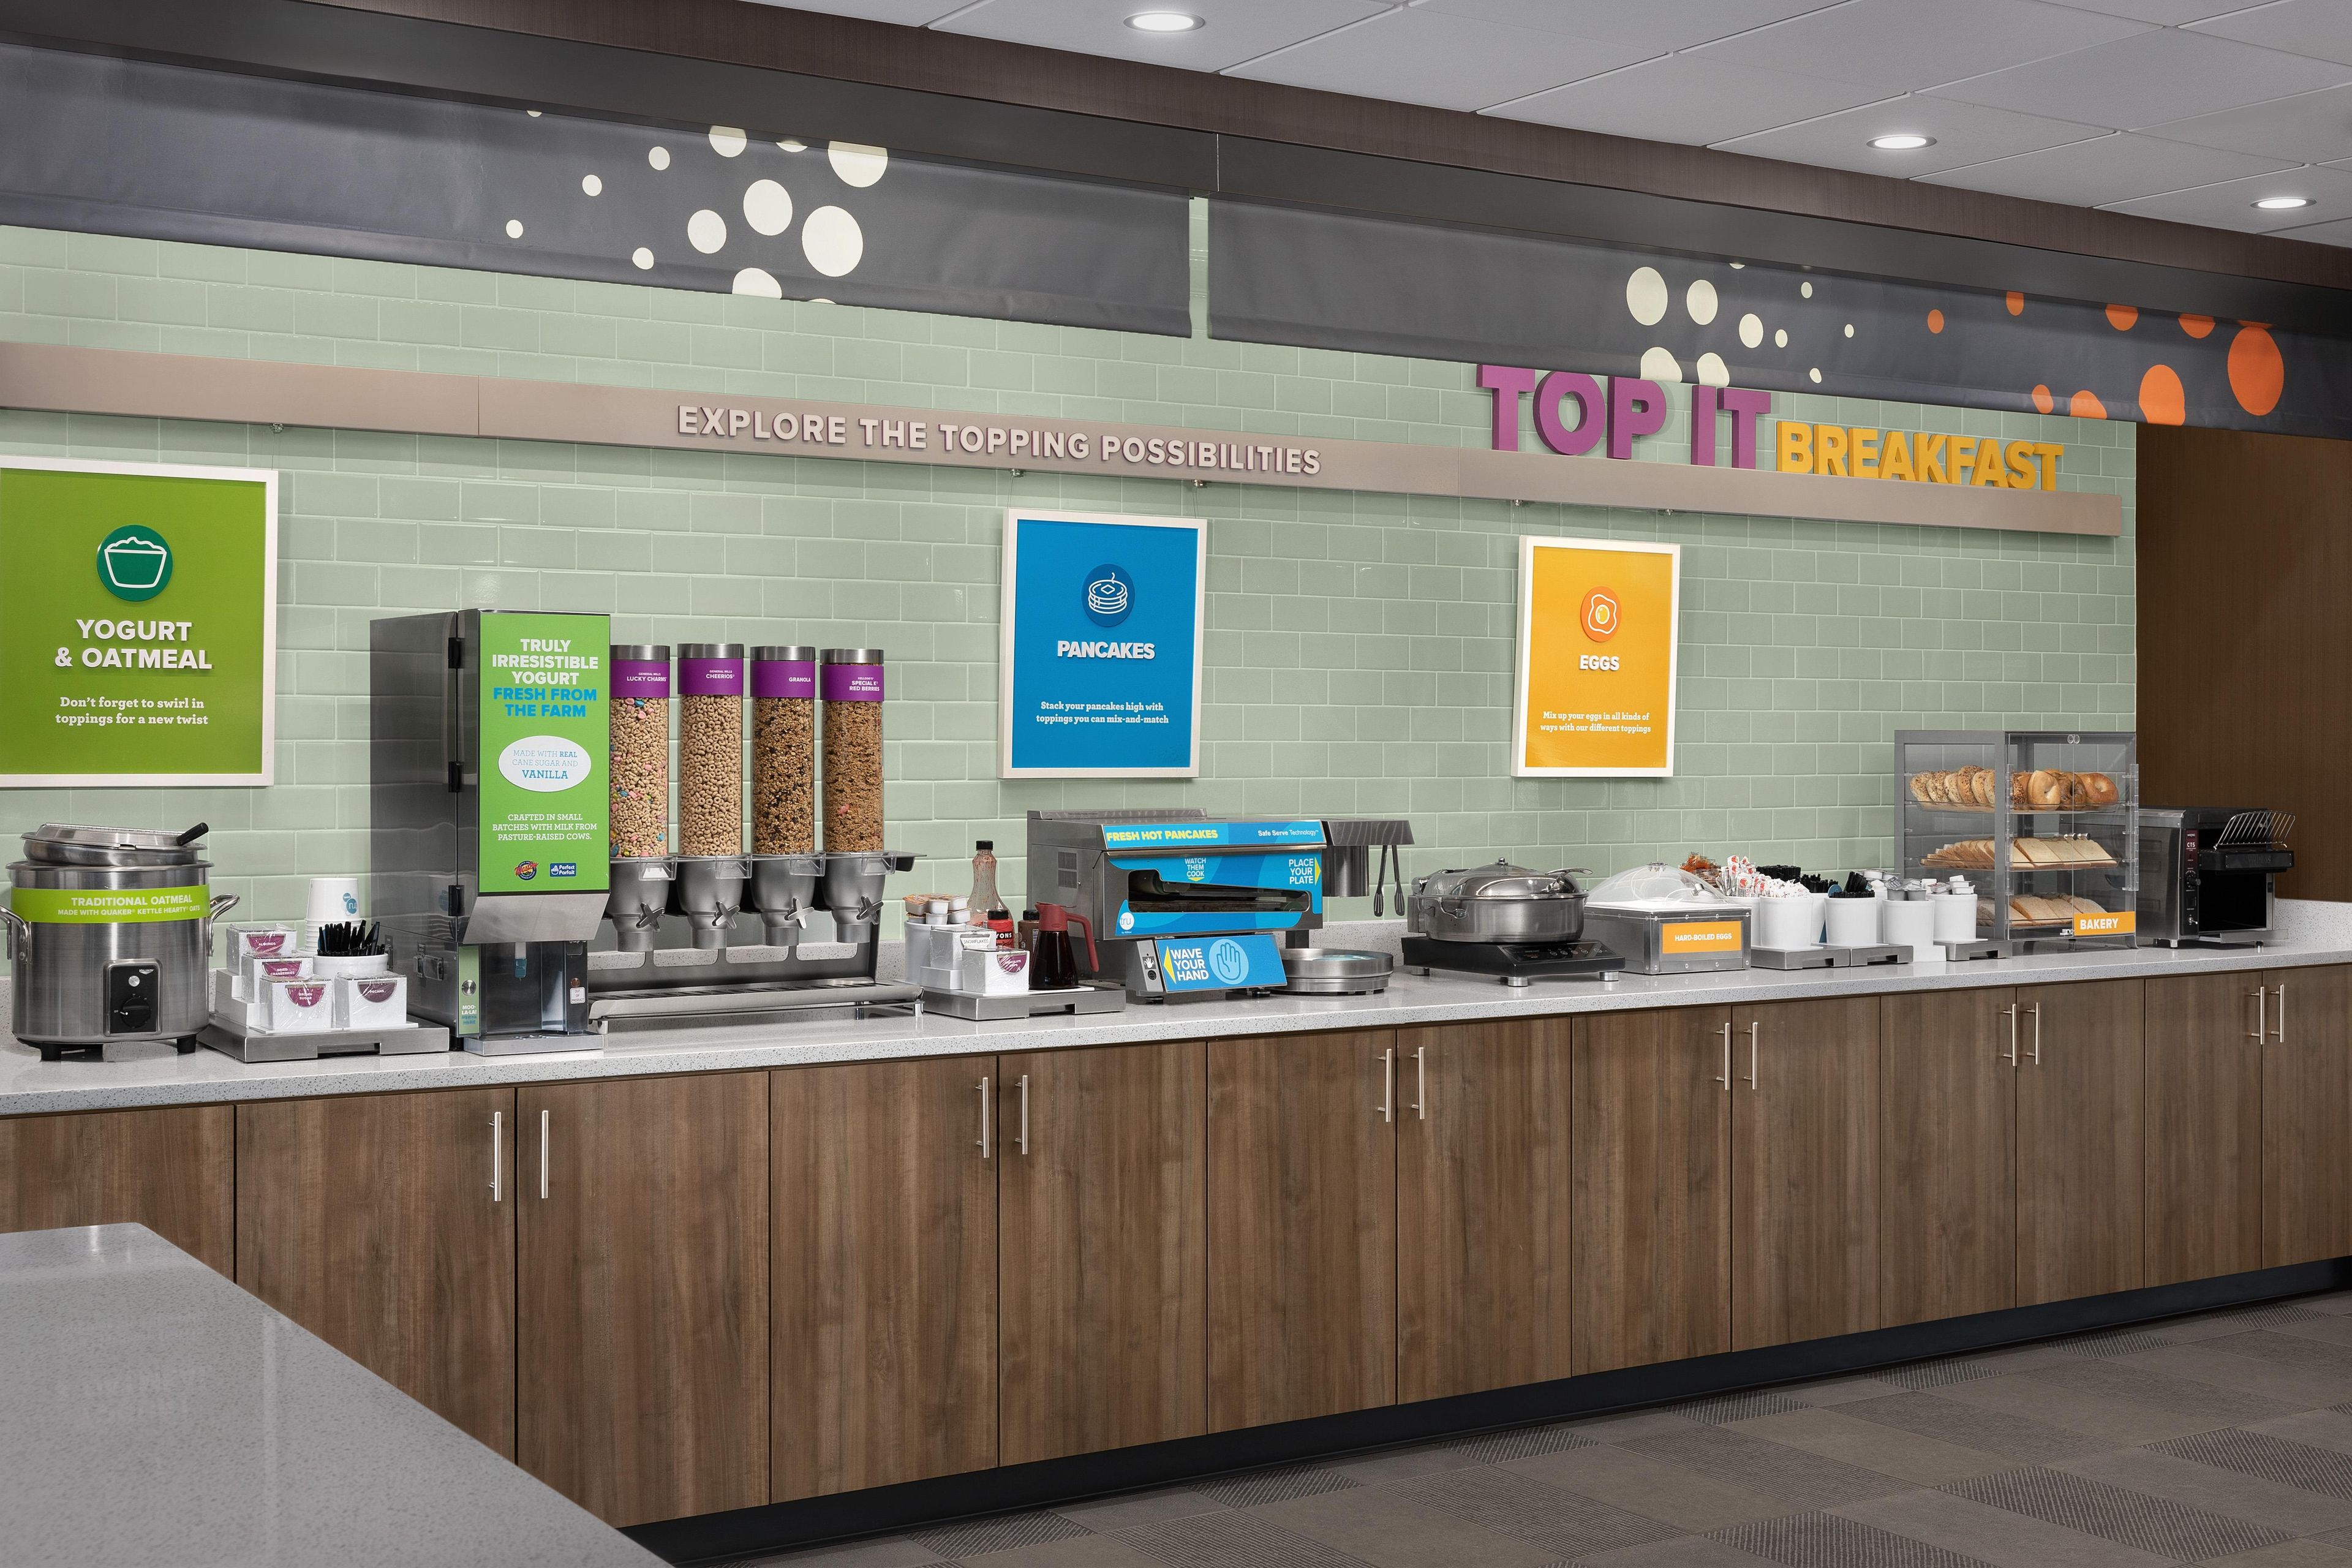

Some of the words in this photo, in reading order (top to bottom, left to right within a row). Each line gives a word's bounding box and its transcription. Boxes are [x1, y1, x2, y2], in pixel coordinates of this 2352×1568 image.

[1476, 364, 1667, 459] TOP
[1691, 384, 1771, 470] IT
[678, 405, 846, 444] EXPLORE
[859, 418, 927, 449] THE
[938, 423, 1089, 459] TOPPING
[1101, 435, 1321, 475] POSSIBILITIES
[1776, 420, 2064, 491] BREAKFAST
[77, 619, 192, 641] YOGURT
[520, 639, 571, 652] TRULY
[1057, 640, 1155, 660] PANCAKES
[55, 647, 73, 667] &
[82, 648, 213, 669] OATMEAL
[492, 655, 598, 669] IRRESISTIBLE
[1578, 655, 1619, 671] EGGS
[511, 671, 579, 685] YOGURT
[493, 687, 545, 700] FRESH
[551, 688, 597, 701] FROM
[60, 697, 96, 707] Don't
[99, 697, 138, 710] forget
[141, 699, 154, 708] to
[157, 698, 189, 708] swirl
[192, 698, 204, 708] in
[1041, 701, 1064, 710] Stack
[1065, 703, 1085, 712] your
[1086, 702, 1124, 712] pancakes
[1126, 702, 1144, 712] high
[505, 704, 536, 717] THE
[541, 704, 586, 717] FARM
[55, 714, 113, 726] toppings
[116, 713, 135, 724] for
[138, 715, 147, 724] a
[149, 715, 174, 724] new
[176, 714, 208, 725] twist
[1036, 714, 1072, 724] toppings
[1074, 716, 1089, 725] you
[1107, 715, 1169, 723] mix-and-match
[1621, 725, 1651, 734] toppings
[522, 770, 568, 779] VANILLA
[1107, 832, 1139, 842] FRESH
[1142, 831, 1163, 840] HOT
[1166, 829, 1218, 839] PANCAKES
[1289, 858, 1314, 867] PLACE
[1290, 867, 1313, 876] YOUR
[1289, 876, 1314, 884] PLATE
[72, 897, 148, 906] TRADITIONAL
[151, 895, 192, 905] OATMEAL
[2080, 918, 2118, 930] BAKERY
[1170, 948, 1202, 959] WAVE
[1174, 959, 1205, 970] YOUR
[1177, 970, 1209, 981] HAND
